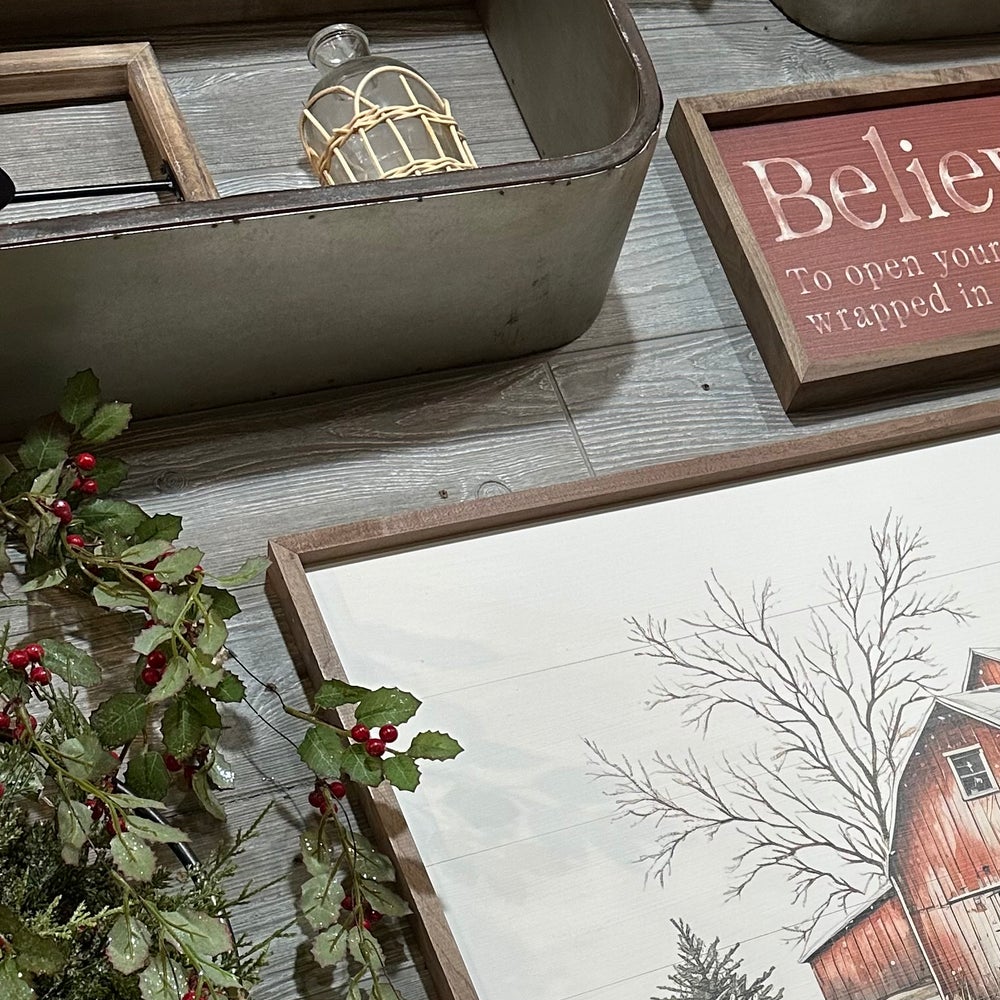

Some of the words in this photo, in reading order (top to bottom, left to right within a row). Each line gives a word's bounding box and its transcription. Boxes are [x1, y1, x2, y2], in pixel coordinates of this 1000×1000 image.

[786, 266, 833, 295] To
[845, 253, 925, 291] open
[806, 282, 952, 335] wrapped
[957, 282, 994, 310] in
